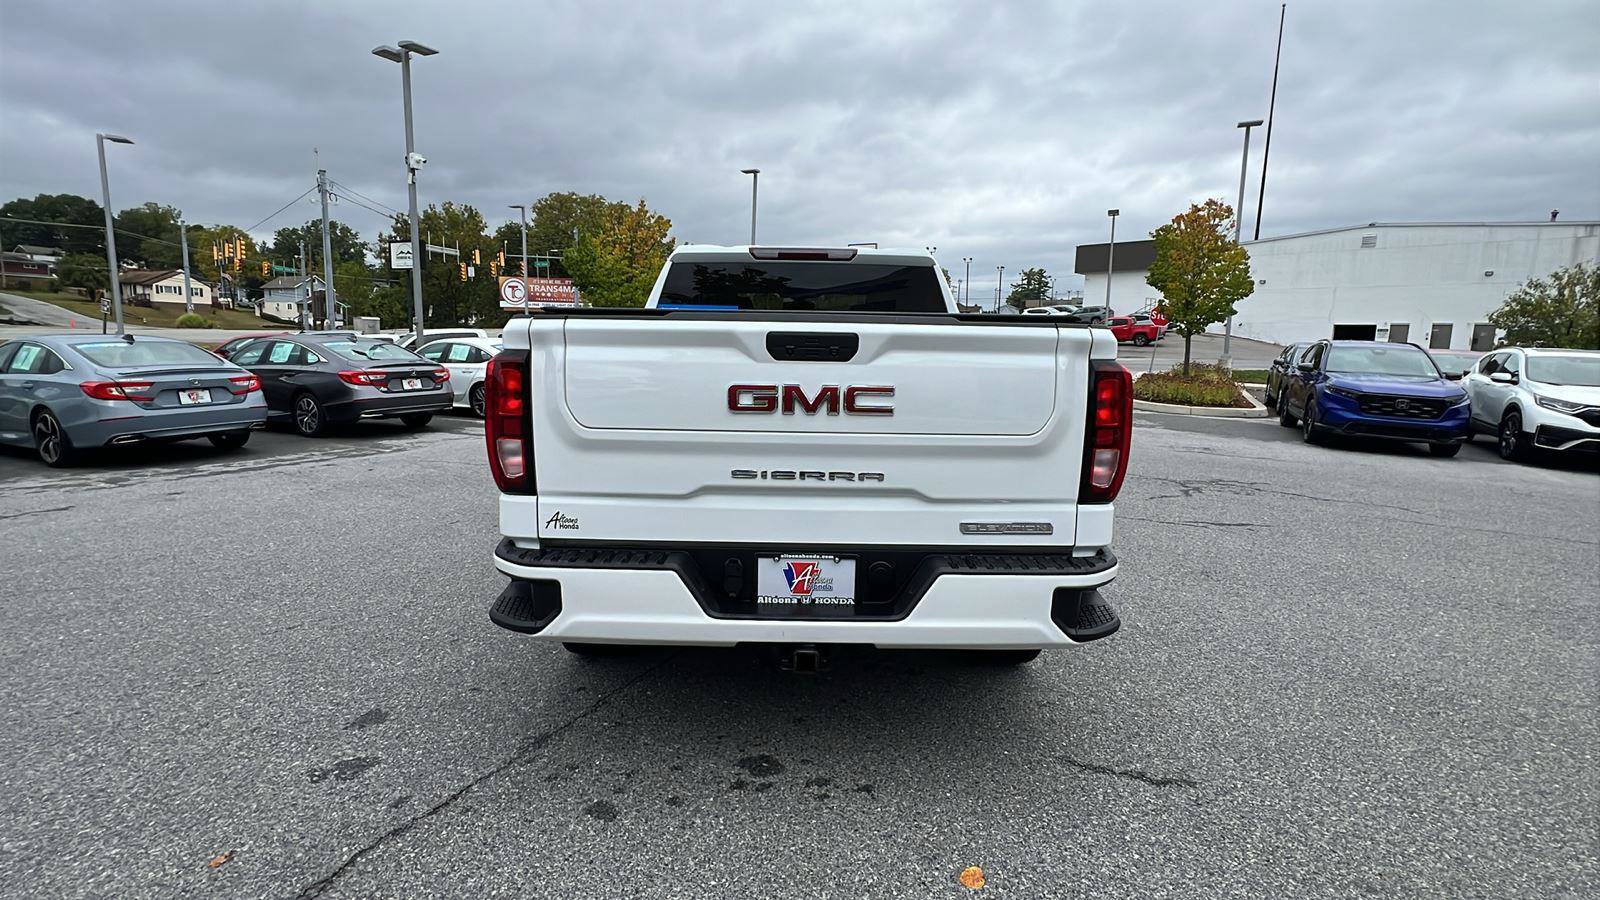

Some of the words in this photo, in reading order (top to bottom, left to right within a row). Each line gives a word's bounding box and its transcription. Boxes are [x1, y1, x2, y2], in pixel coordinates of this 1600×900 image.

[727, 384, 895, 416] GMC
[731, 469, 885, 482] SIERRA
[757, 596, 798, 604] Altoona
[814, 597, 855, 605] HONDA
